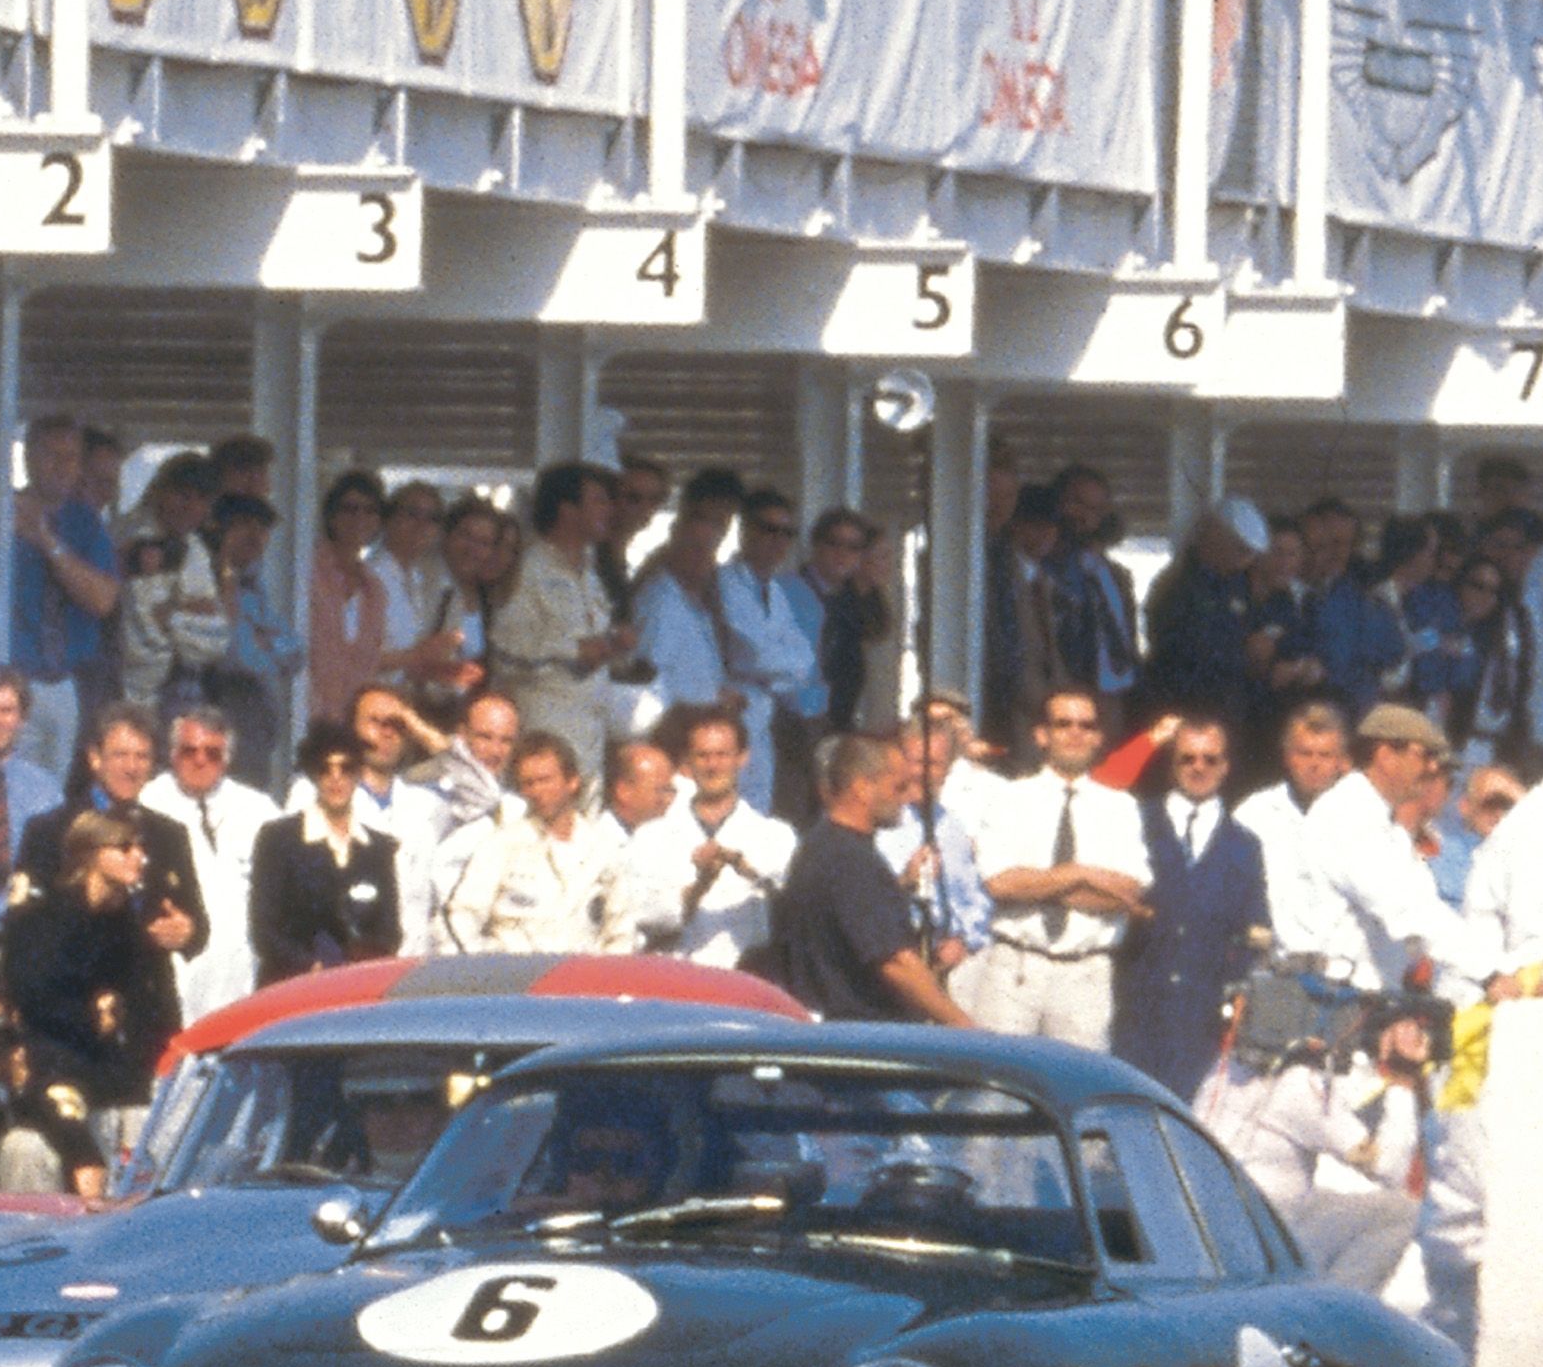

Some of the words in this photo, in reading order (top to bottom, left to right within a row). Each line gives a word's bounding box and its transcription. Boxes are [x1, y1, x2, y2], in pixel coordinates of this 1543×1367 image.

[40, 151, 87, 227] 2
[355, 193, 399, 263] 3
[636, 230, 681, 299] 4
[912, 264, 951, 330] 5
[1163, 297, 1204, 359] 6
[449, 1274, 559, 1343] 6
